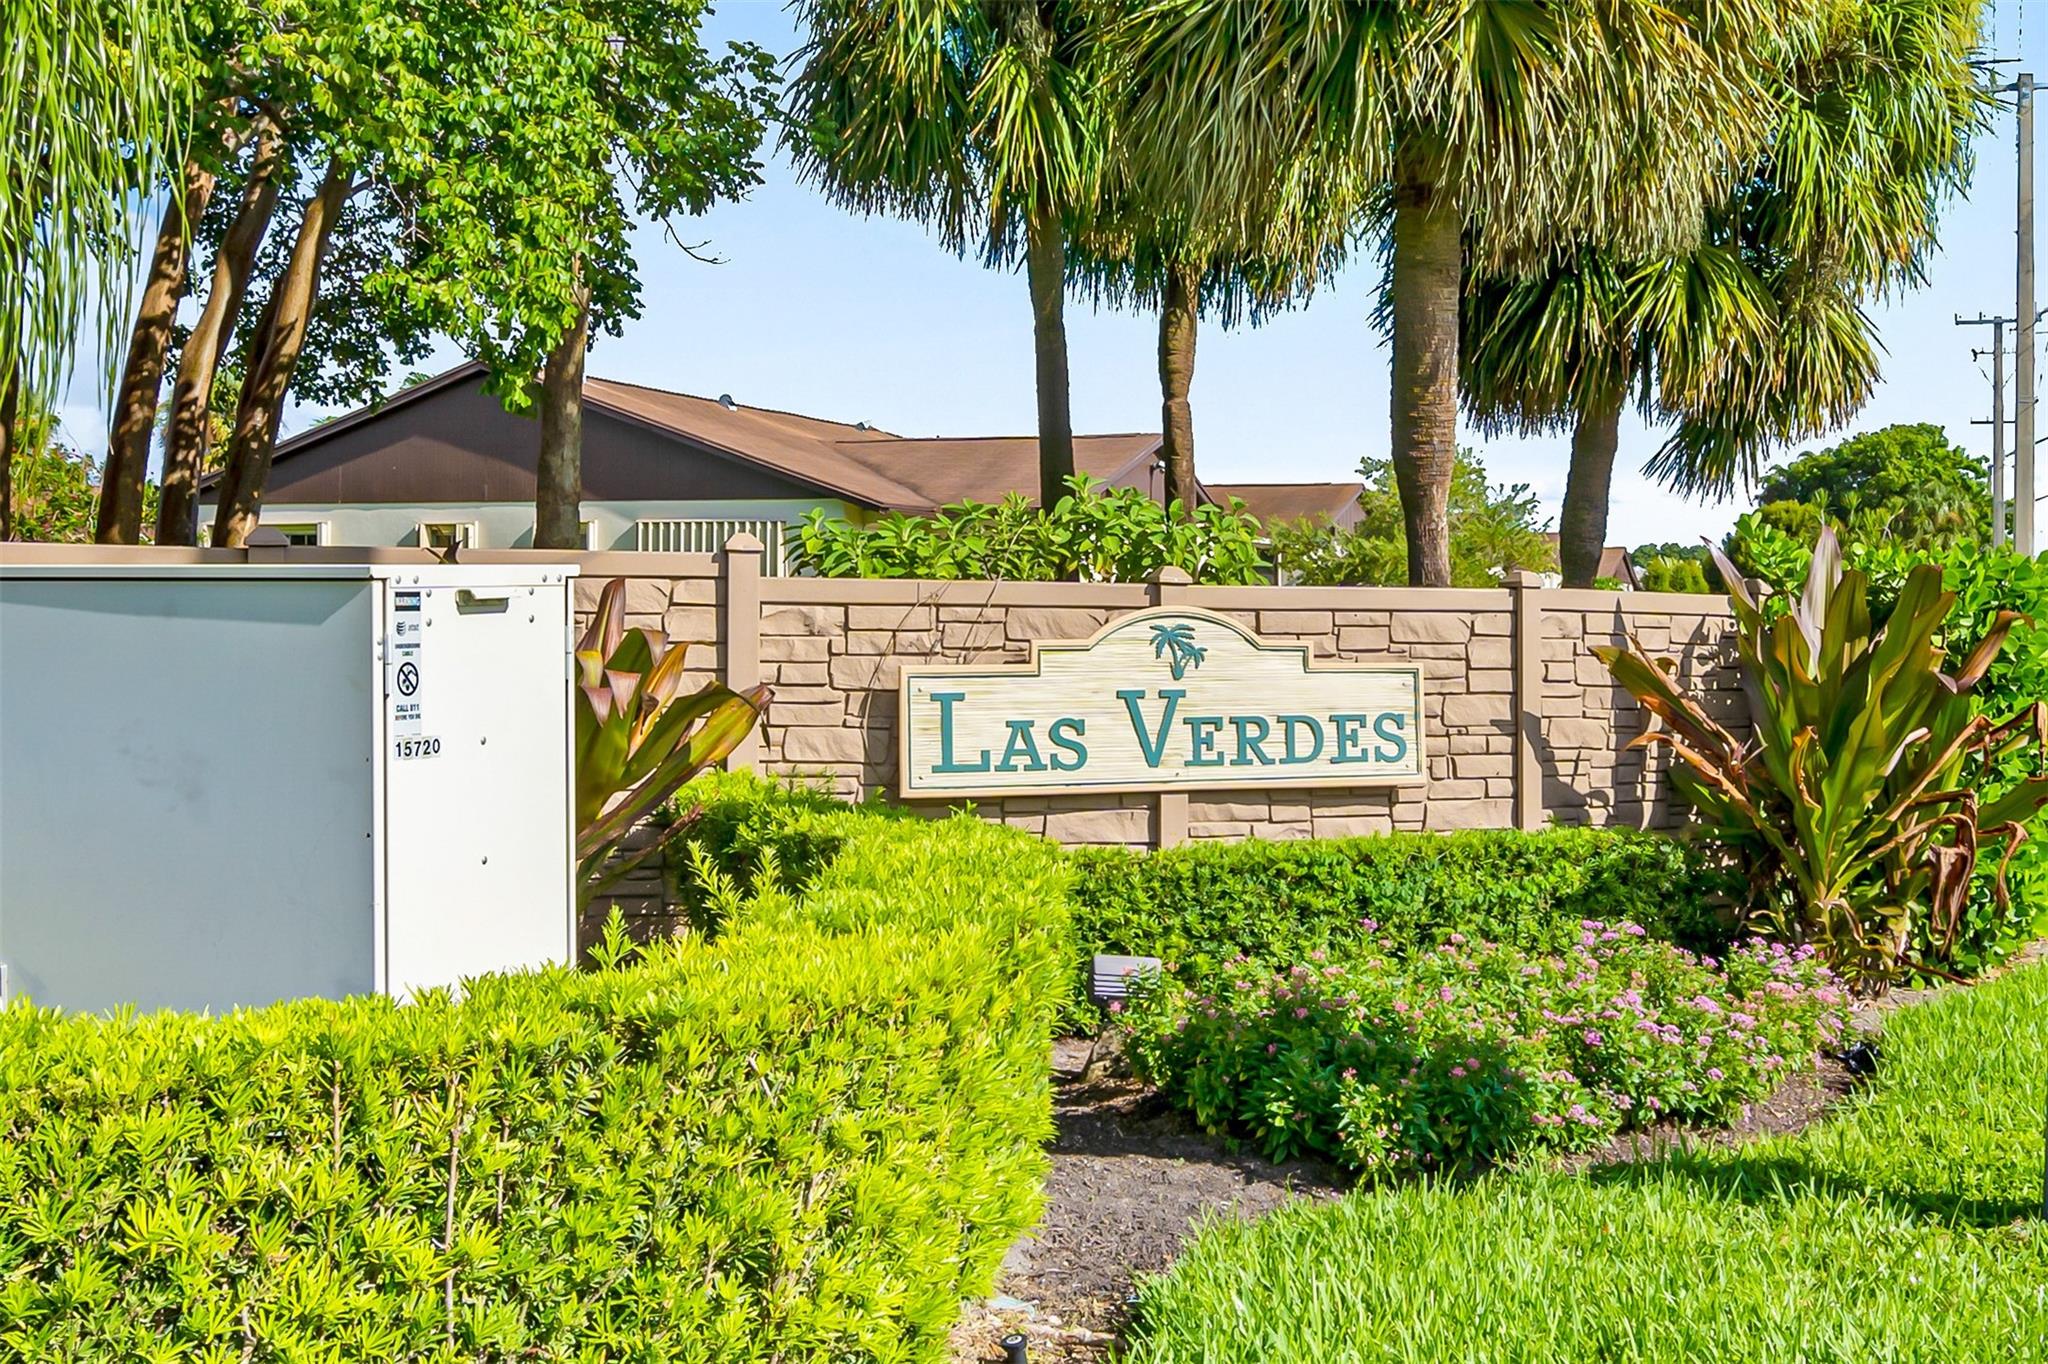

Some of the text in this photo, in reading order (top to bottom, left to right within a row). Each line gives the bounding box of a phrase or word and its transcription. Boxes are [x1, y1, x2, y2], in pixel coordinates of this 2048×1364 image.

[396, 704, 408, 712] CALL
[930, 689, 1408, 773] LAS VERDES
[395, 738, 440, 757] 15720
